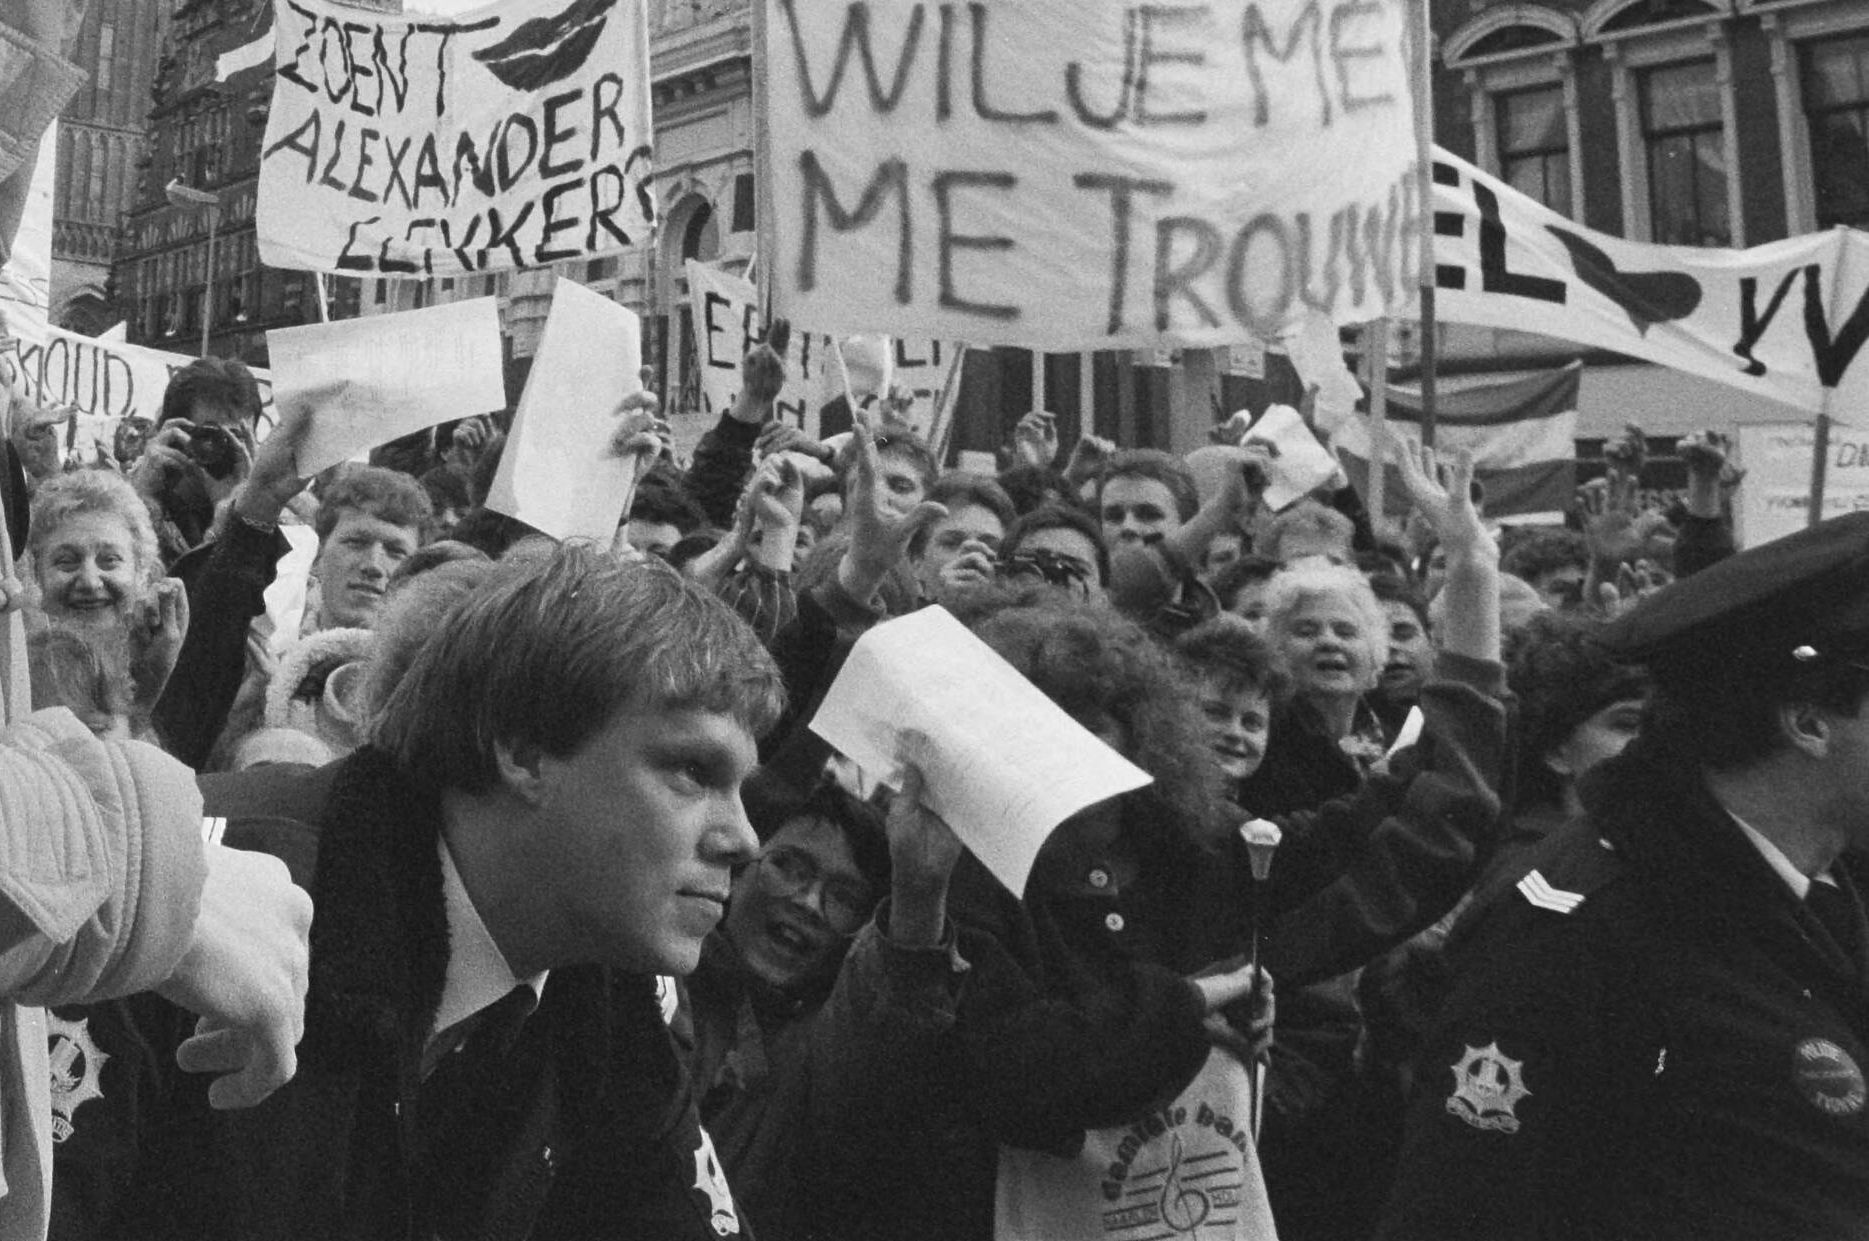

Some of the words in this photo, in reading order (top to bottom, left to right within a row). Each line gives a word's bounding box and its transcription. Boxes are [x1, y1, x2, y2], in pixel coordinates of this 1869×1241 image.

[1065, 3, 1208, 130] JE
[262, 71, 626, 210] ALEXANDER
[795, 149, 1021, 323] ME
